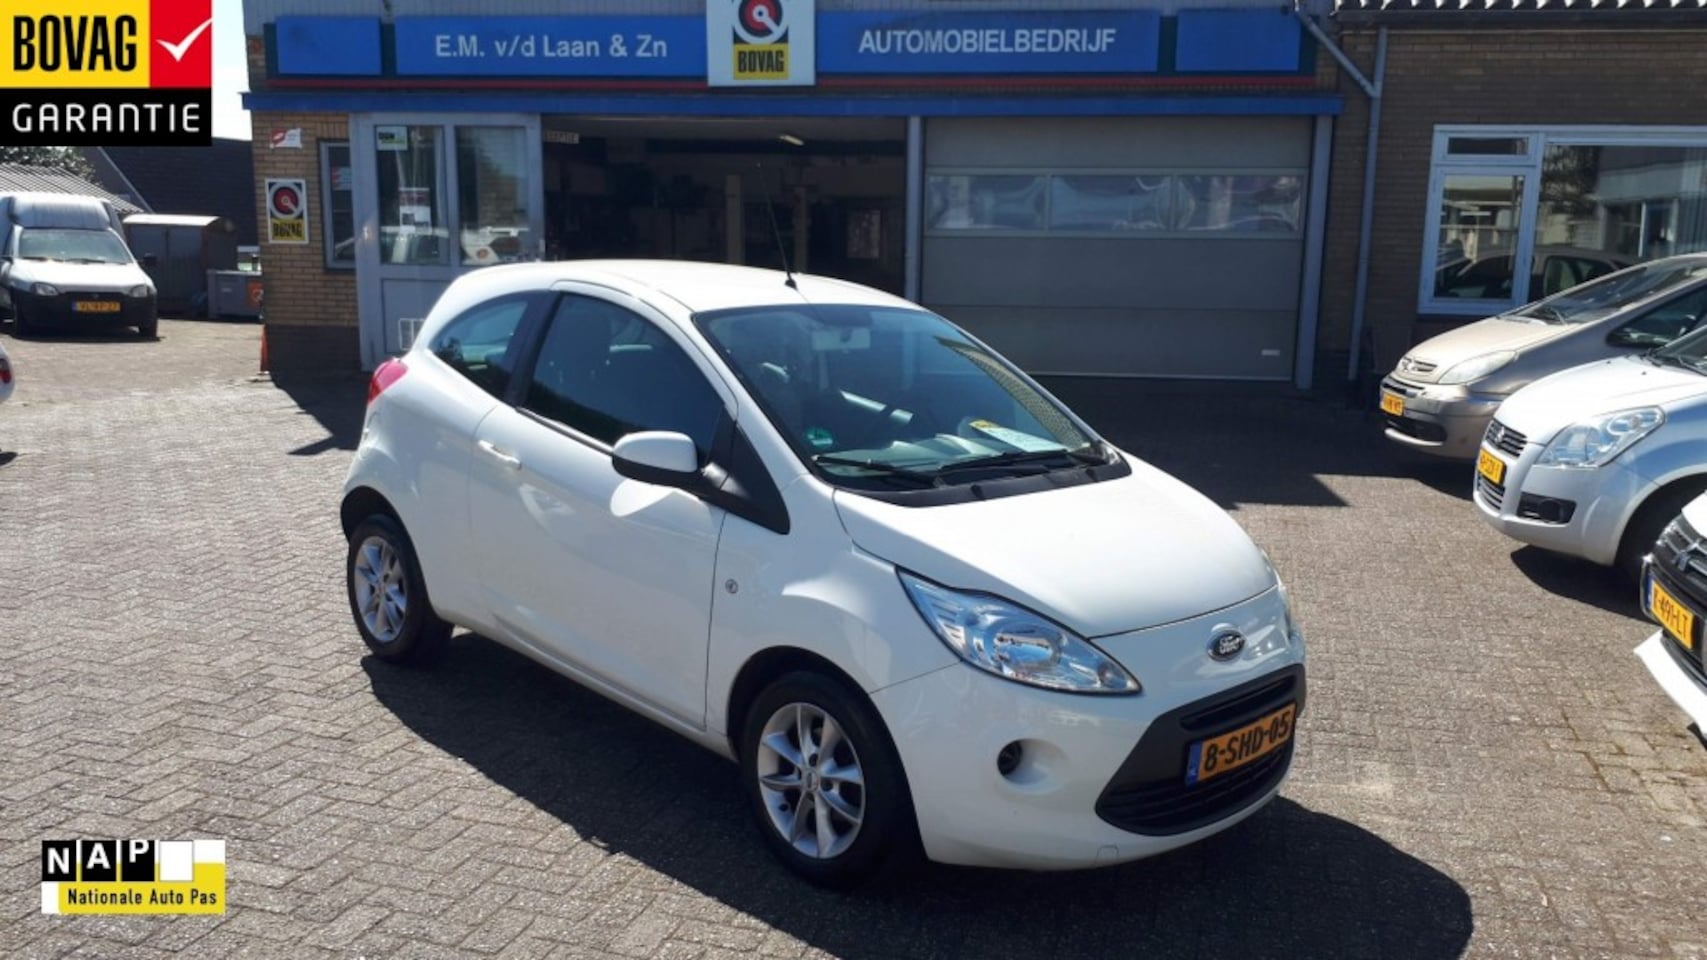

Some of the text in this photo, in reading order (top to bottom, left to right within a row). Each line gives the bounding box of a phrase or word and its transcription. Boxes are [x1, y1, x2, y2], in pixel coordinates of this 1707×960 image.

[436, 33, 667, 57] E.M. v/d Laan & Zn
[859, 28, 1117, 54] AUTOMOBIELBEDRIJF
[737, 49, 785, 73] BOVAG
[1203, 710, 1292, 773] 8-SHD-05
